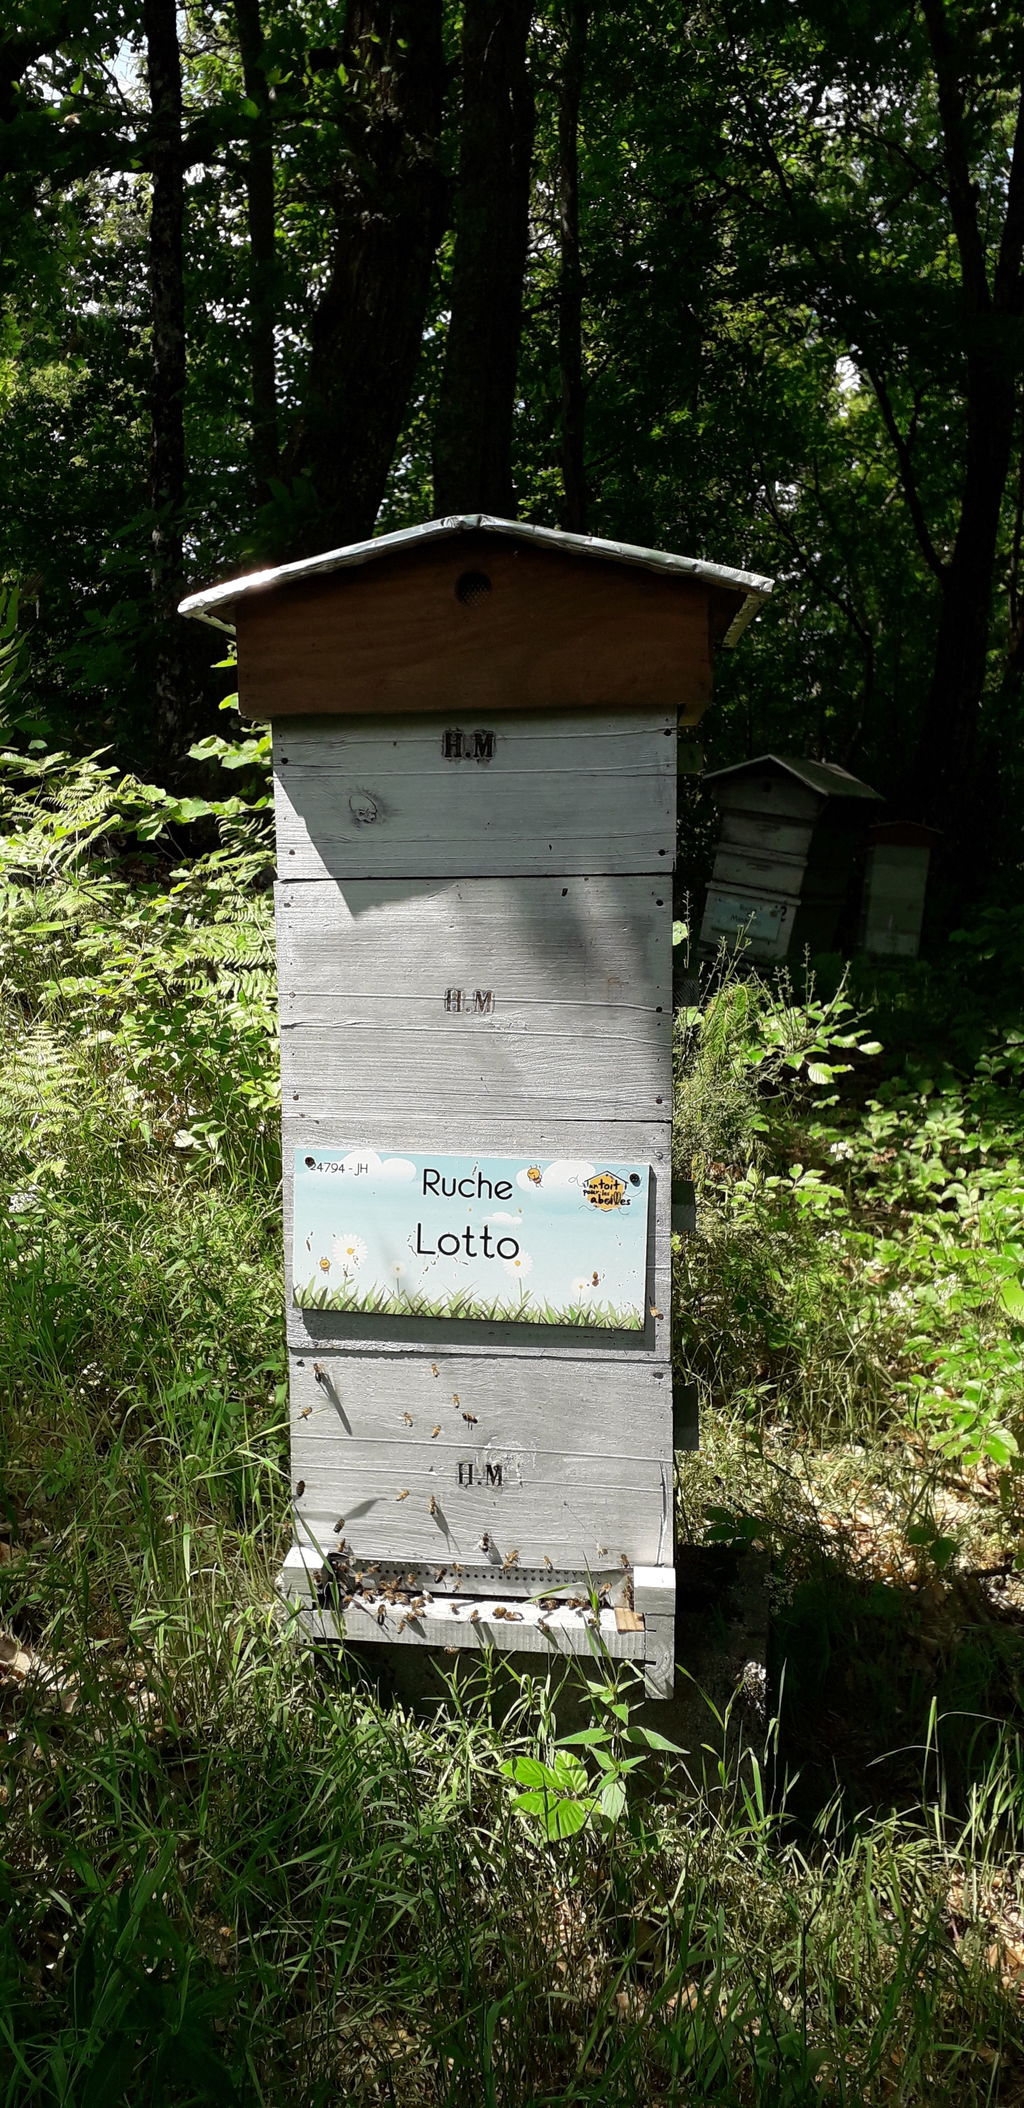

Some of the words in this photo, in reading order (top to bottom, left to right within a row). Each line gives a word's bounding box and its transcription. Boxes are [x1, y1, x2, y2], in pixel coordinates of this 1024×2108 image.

[444, 732, 494, 757] H.M
[445, 989, 494, 1013] H.M
[354, 1163, 368, 1176] JH
[422, 1168, 513, 1200] Ruche
[598, 1178, 621, 1190] toit
[590, 1191, 631, 1206] abeilles
[417, 1222, 520, 1260] Lotto
[457, 1463, 504, 1487] H.M
